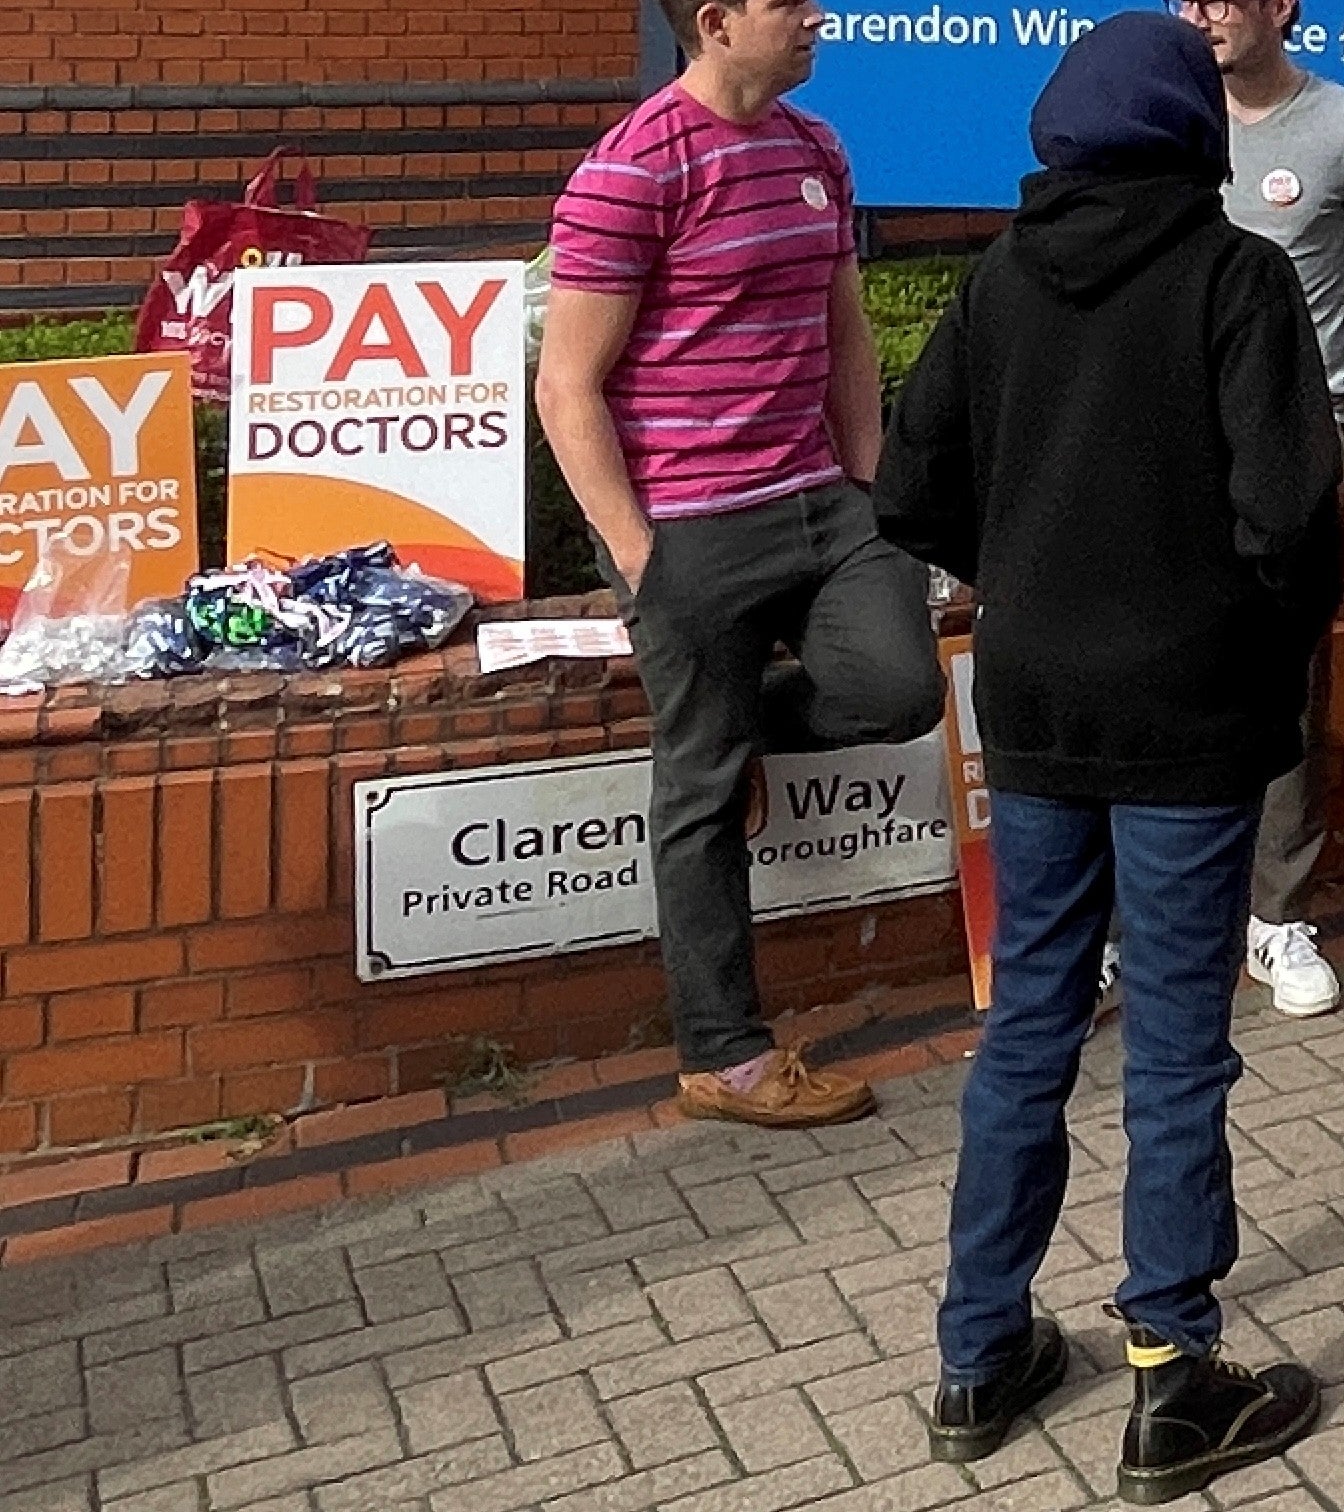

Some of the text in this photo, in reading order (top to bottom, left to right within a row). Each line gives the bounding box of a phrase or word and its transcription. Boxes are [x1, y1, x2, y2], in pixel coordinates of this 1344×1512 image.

[819, 5, 1096, 46] arendon Win
[250, 279, 508, 385] PAY
[0, 369, 174, 482] AY
[247, 385, 447, 414] RESTORATION
[456, 382, 509, 405] FOR
[247, 410, 509, 462] DOCTORS
[118, 478, 180, 506] FOR
[452, 774, 906, 866] Claren Way
[402, 818, 948, 917] Private Road oroughfare
